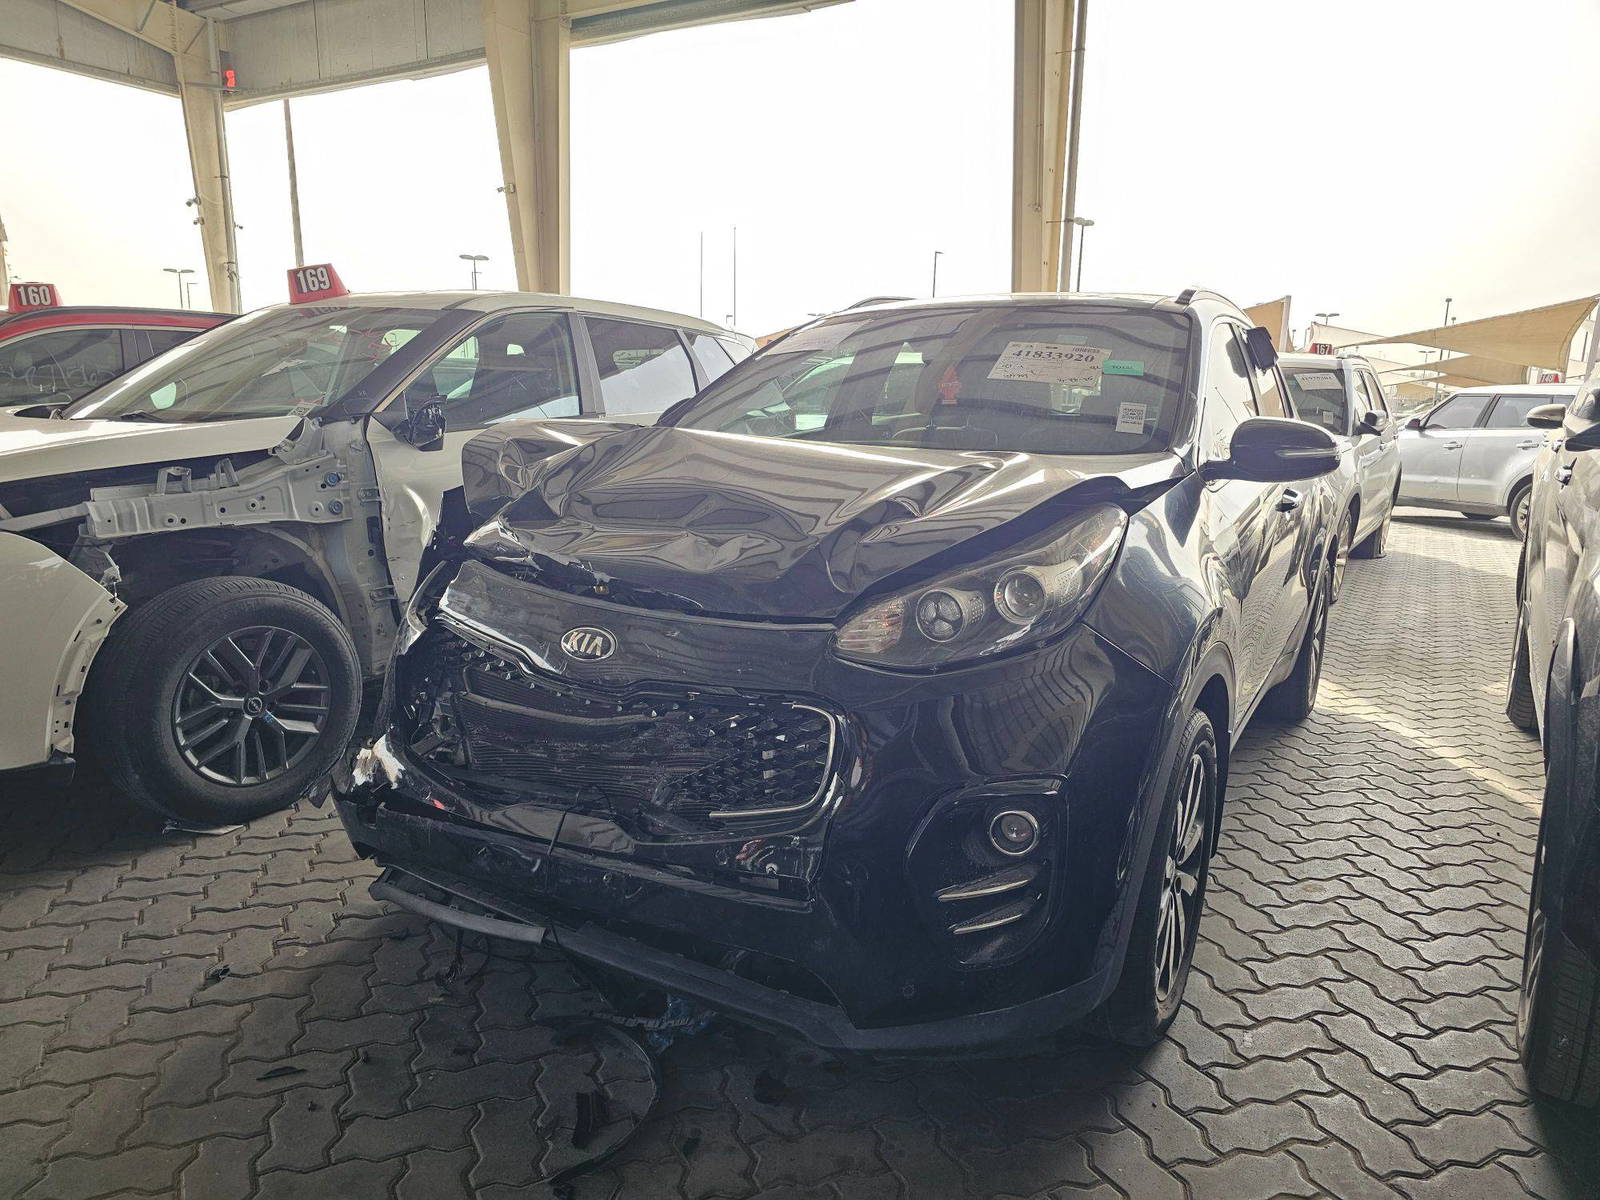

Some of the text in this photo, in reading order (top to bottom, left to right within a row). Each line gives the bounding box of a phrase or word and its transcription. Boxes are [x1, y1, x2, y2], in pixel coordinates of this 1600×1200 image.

[296, 267, 330, 293] 169
[18, 286, 52, 306] 160
[1012, 348, 1095, 363] 41833920
[1317, 344, 1330, 355] 167
[564, 631, 604, 656] KIA
